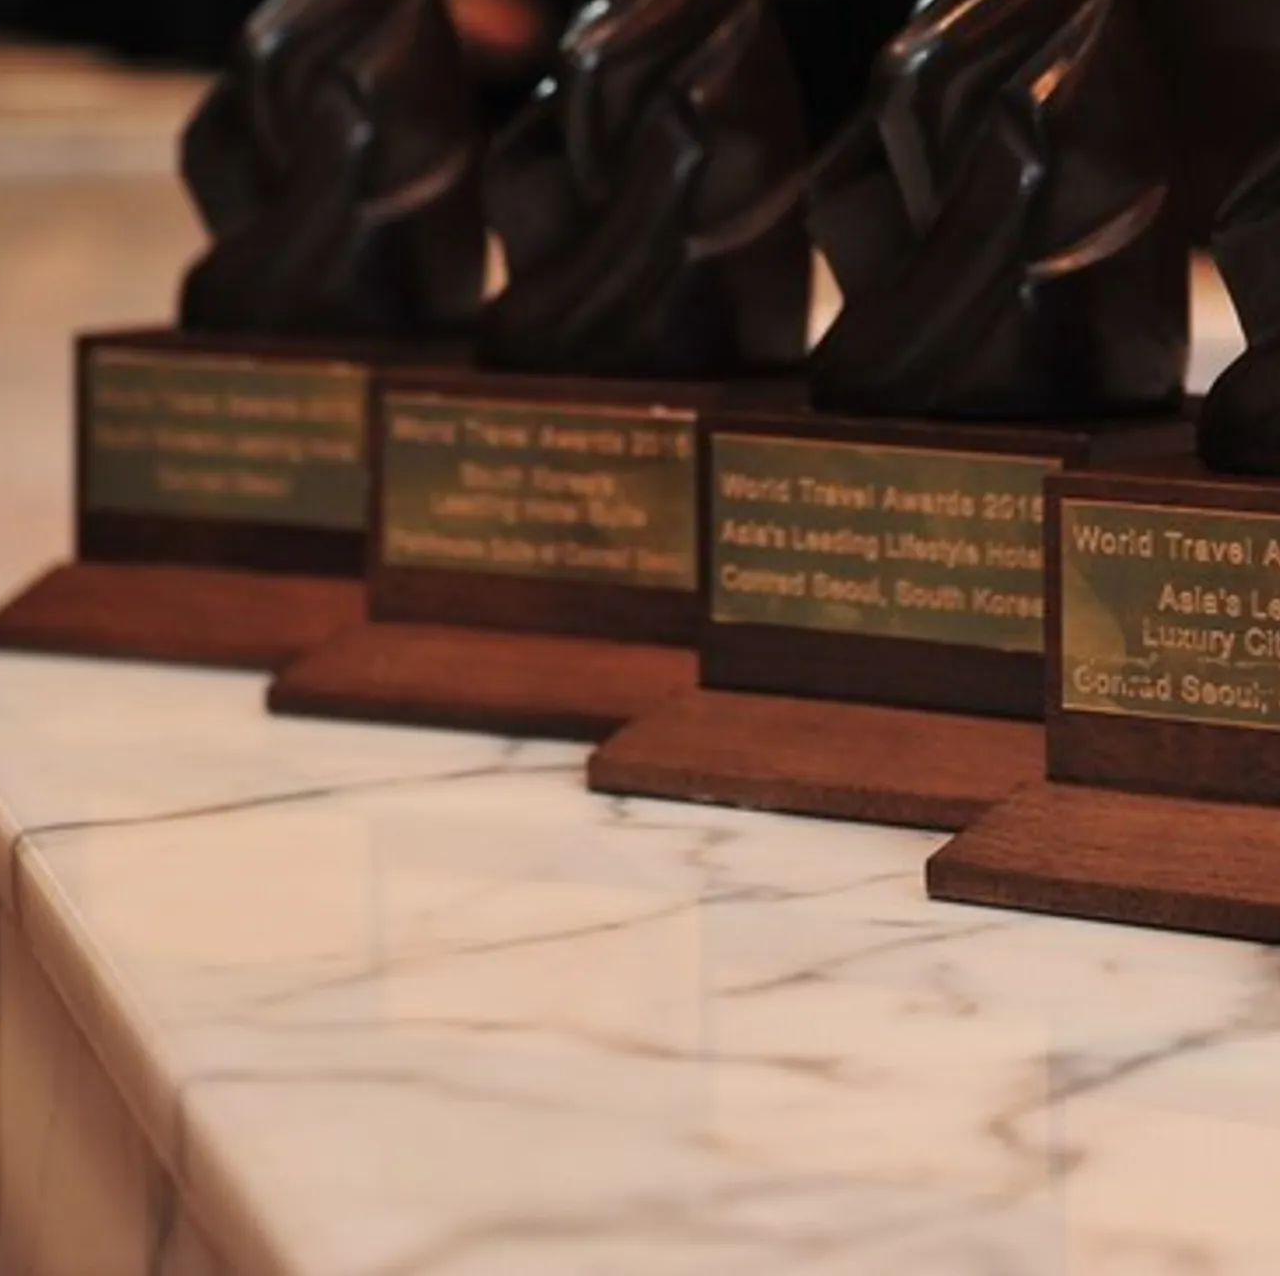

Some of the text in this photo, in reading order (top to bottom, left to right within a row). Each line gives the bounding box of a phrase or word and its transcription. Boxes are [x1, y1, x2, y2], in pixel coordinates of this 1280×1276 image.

[723, 472, 790, 503] World
[799, 476, 875, 509] Travel
[882, 486, 976, 518] Awards
[723, 520, 785, 548] Asia's
[791, 525, 879, 561] Leading
[884, 532, 980, 568] Lifestyle
[1073, 524, 1152, 558] World
[1164, 530, 1254, 567] Travel
[721, 564, 806, 597] Conrad
[895, 580, 965, 611] South
[1158, 583, 1241, 617] Asia's
[1142, 617, 1236, 658] Luxury
[1073, 664, 1171, 701] Conrad
[1181, 673, 1269, 713] Seoul,
